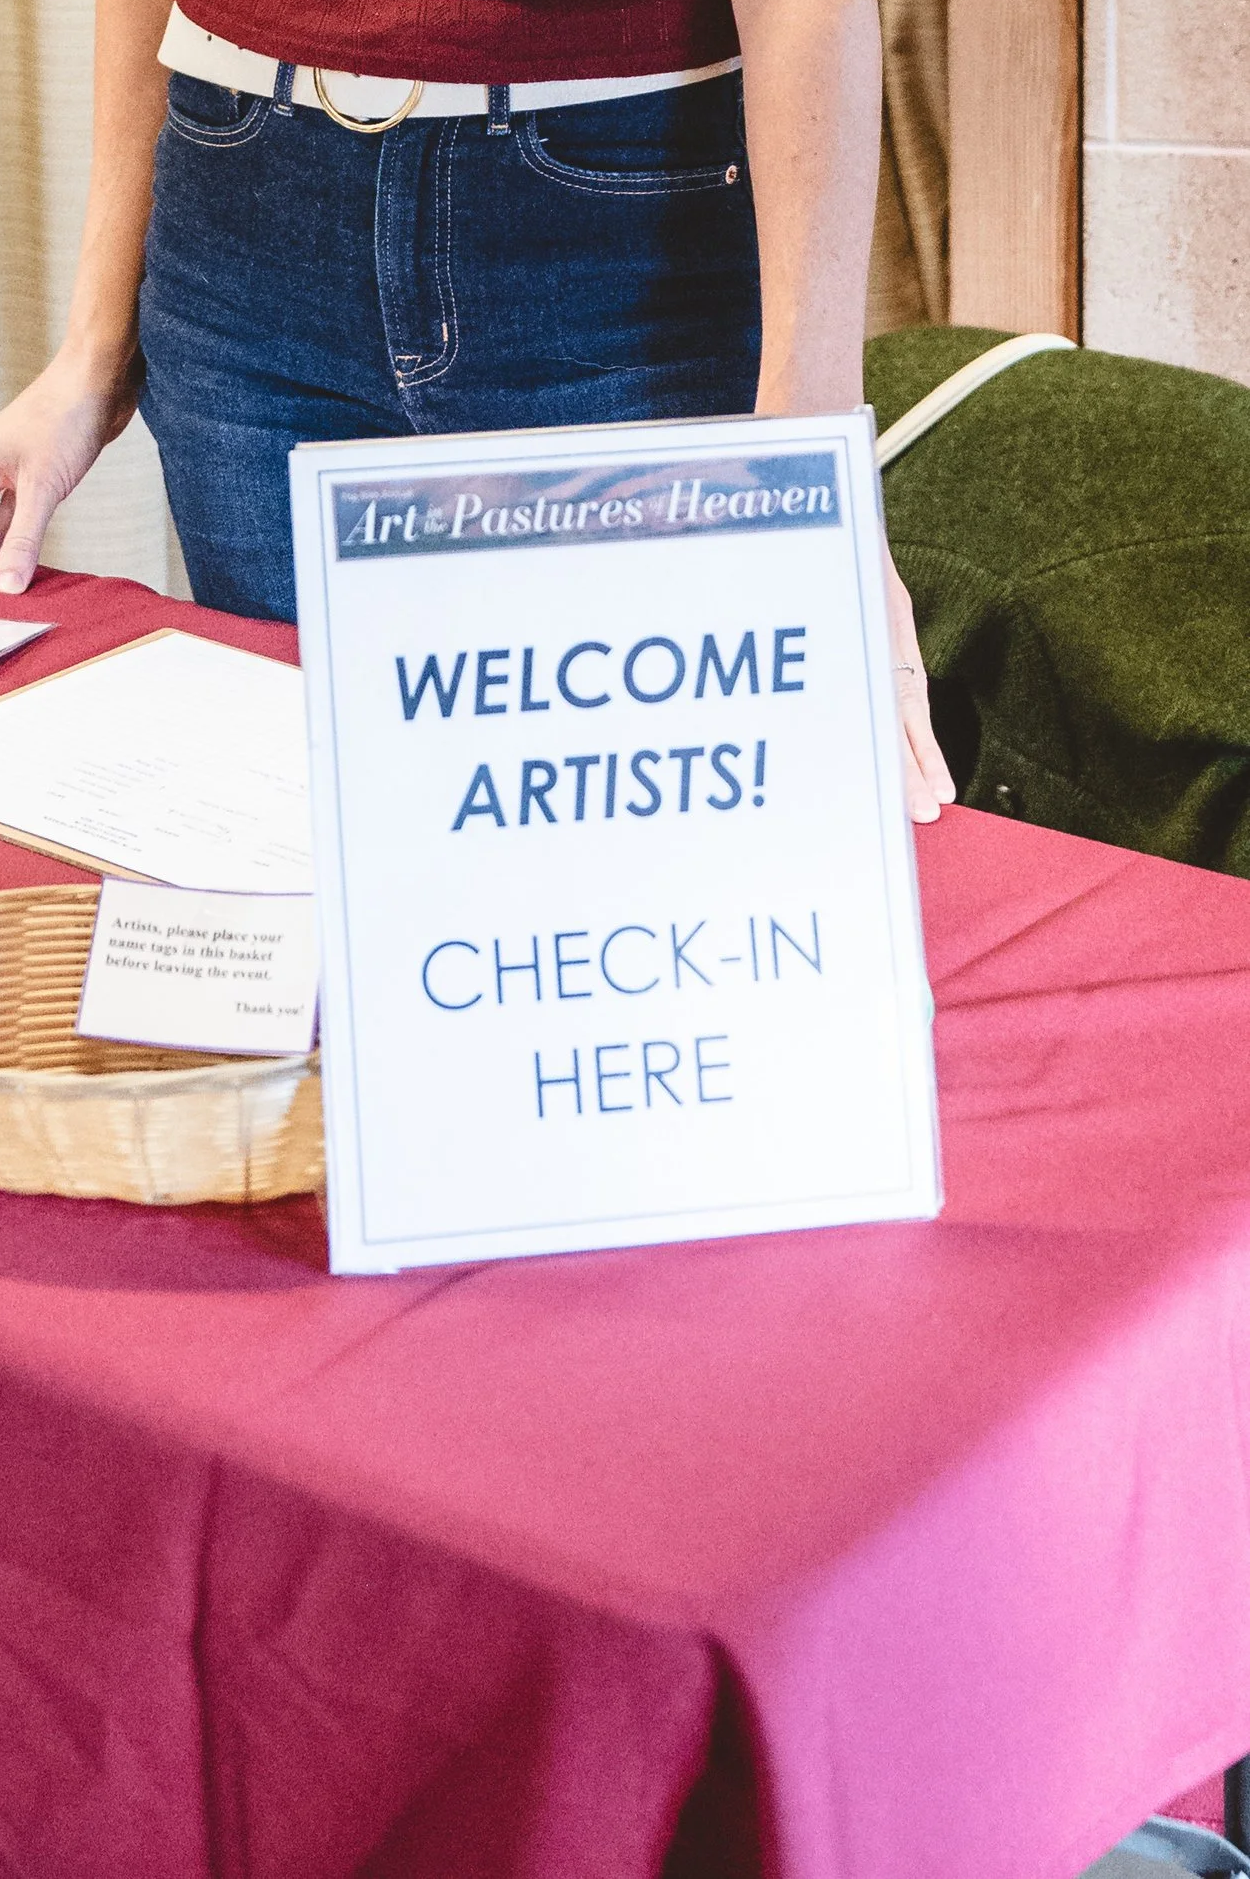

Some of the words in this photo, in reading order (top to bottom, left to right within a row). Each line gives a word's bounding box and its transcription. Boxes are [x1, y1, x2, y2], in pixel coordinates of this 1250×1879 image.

[341, 499, 419, 546] Art
[450, 492, 644, 539] Pastures
[666, 478, 833, 523] Heaven
[395, 627, 807, 721] WELCOME
[450, 740, 767, 831] ARTISTS!
[109, 937, 146, 952] name
[151, 942, 178, 956] tags
[183, 945, 195, 956] in
[200, 946, 225, 959] this
[229, 949, 273, 962] basket
[111, 917, 162, 935] Artists,
[166, 925, 208, 940] please
[213, 929, 248, 944] place
[252, 933, 284, 946] your
[422, 911, 823, 1011] CHECK-IN
[106, 953, 149, 971] before
[154, 959, 203, 979] leaving
[207, 965, 229, 979] the
[235, 1000, 273, 1015] Thank
[534, 1034, 734, 1120] HERE
